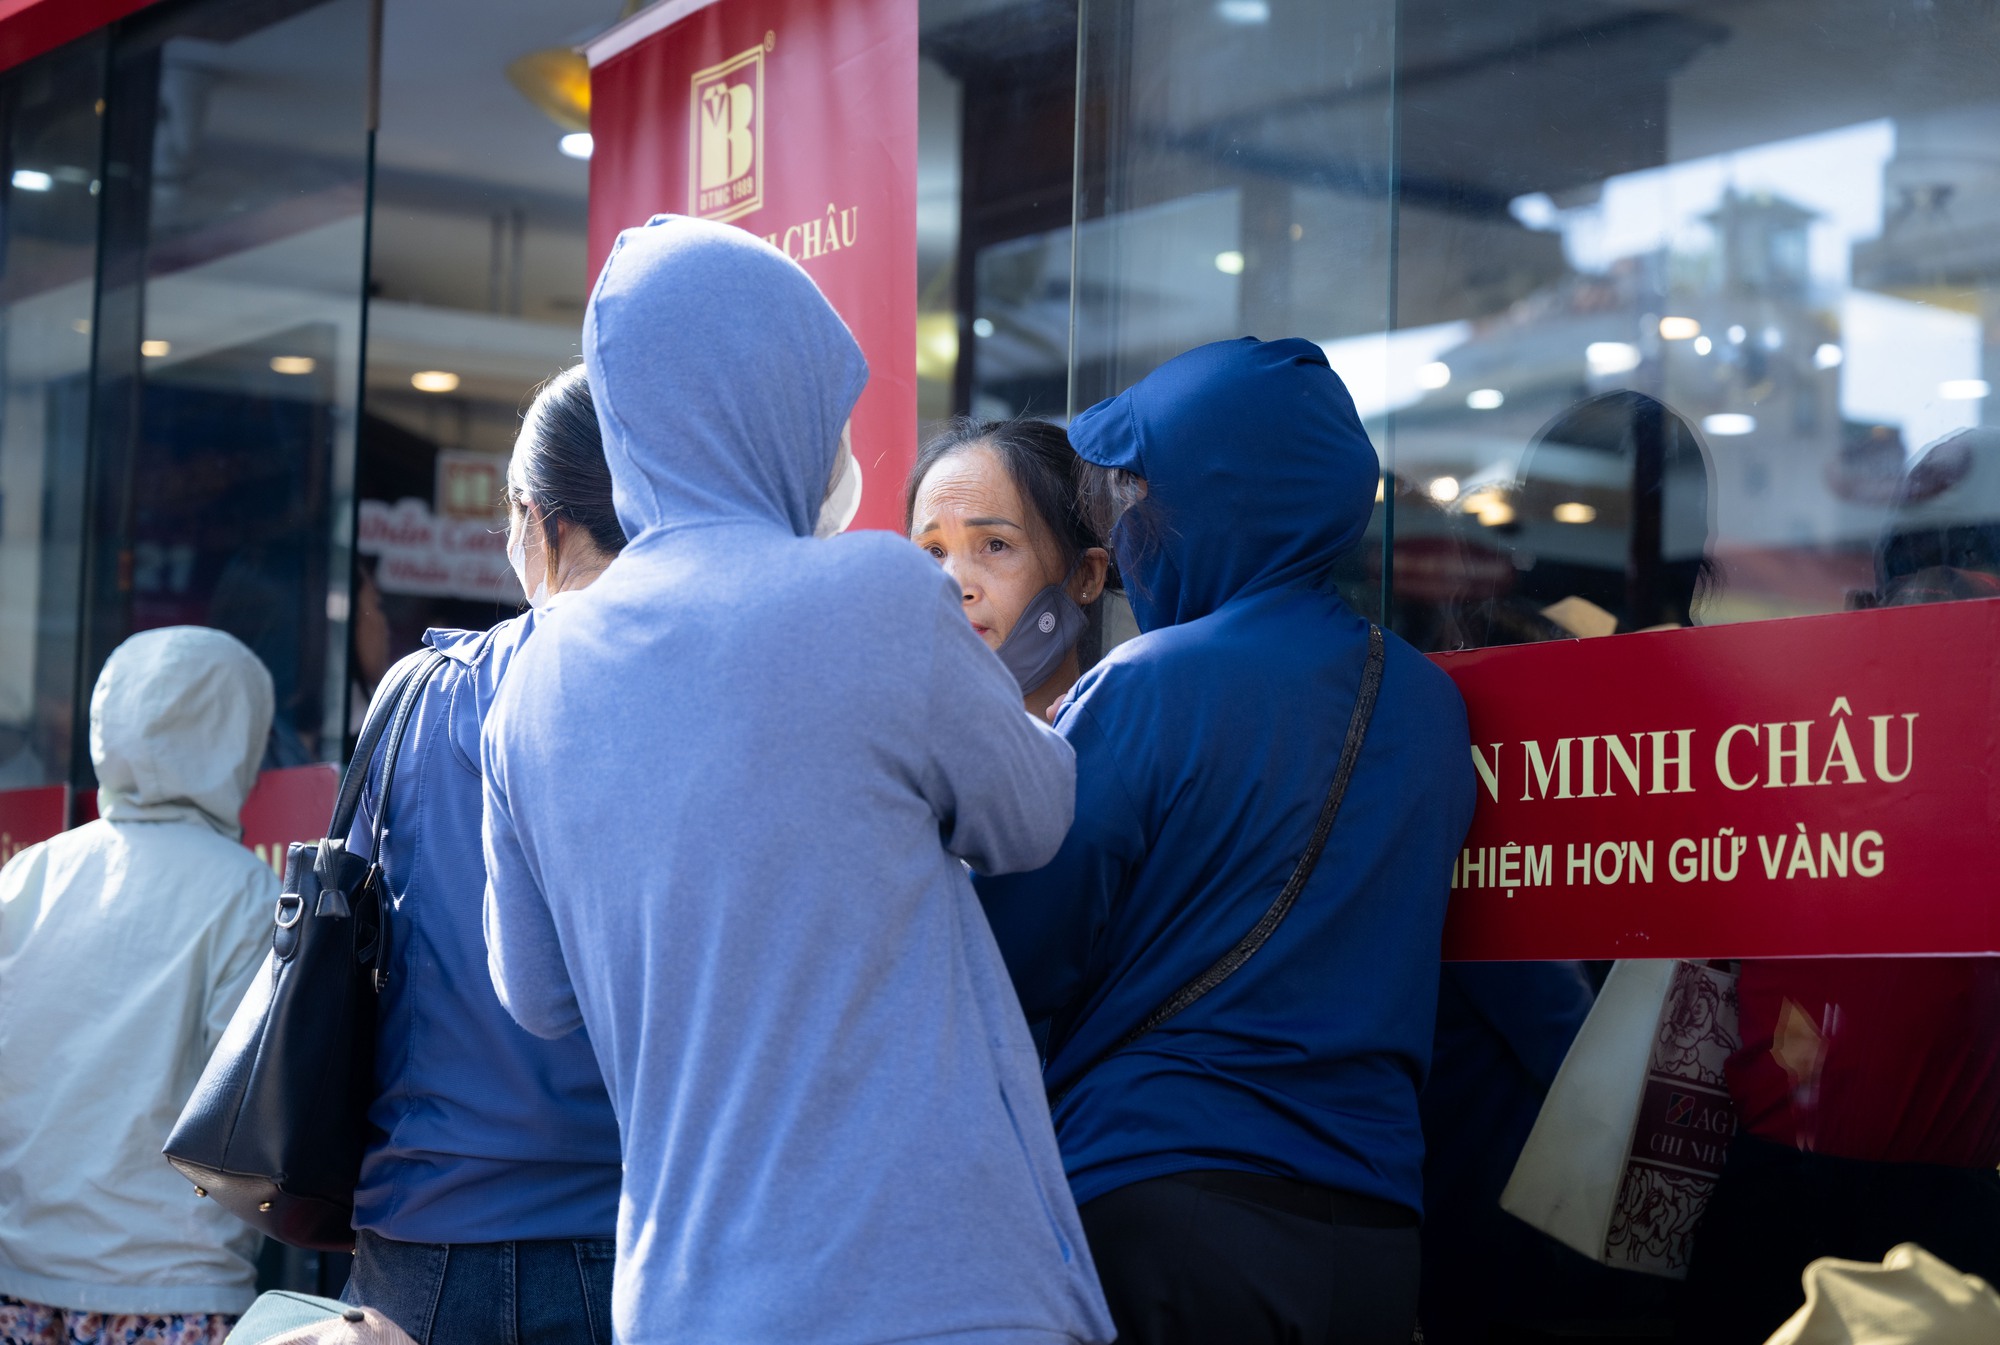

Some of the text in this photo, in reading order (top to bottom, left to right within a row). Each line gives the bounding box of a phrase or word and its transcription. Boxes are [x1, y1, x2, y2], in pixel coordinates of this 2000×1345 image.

[783, 203, 858, 262] CHÂU
[1520, 728, 1696, 802] MINH
[1715, 696, 1920, 791] CHÂU
[1567, 840, 1654, 885] HƠN
[1668, 826, 1747, 883] GIỮ
[1757, 822, 1885, 880] VÀNG
[1650, 1132, 1683, 1156] CHI
